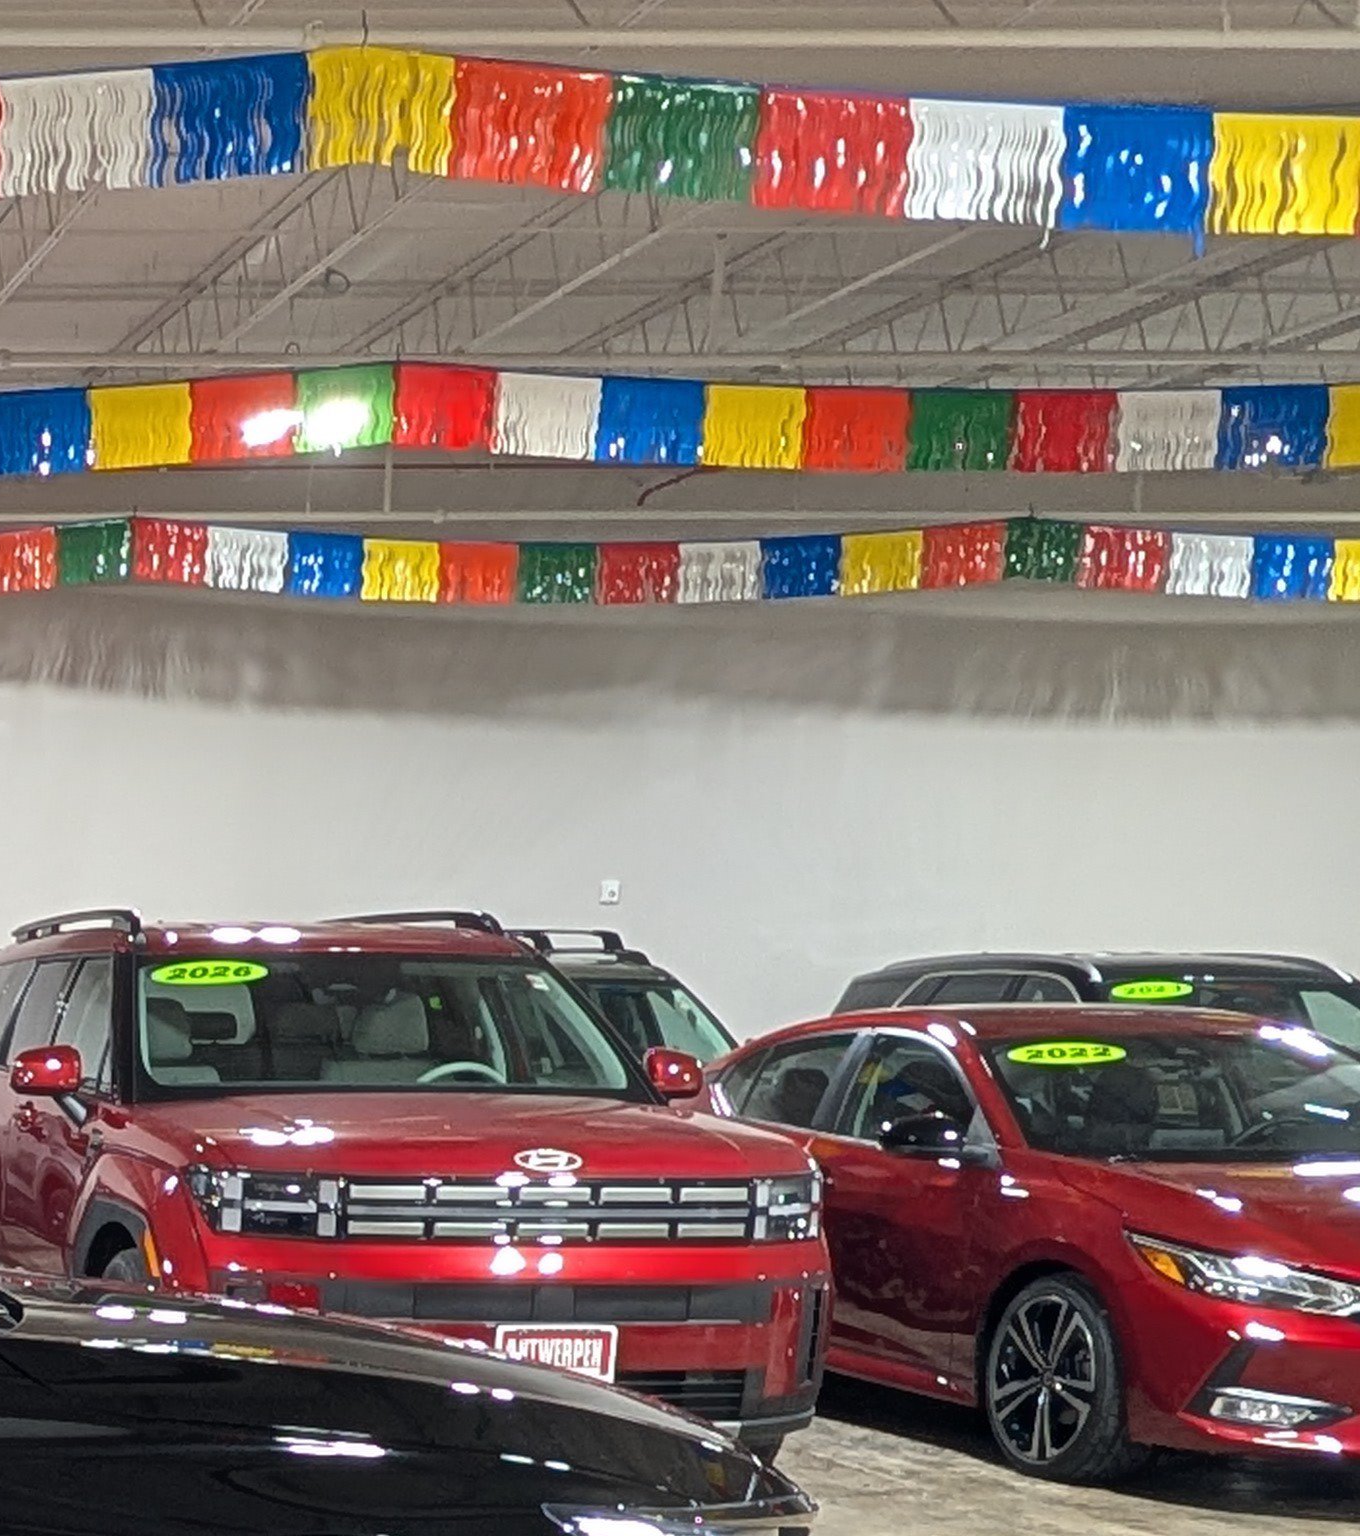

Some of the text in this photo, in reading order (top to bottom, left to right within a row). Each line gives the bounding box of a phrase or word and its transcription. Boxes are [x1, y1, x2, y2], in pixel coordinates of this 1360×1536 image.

[165, 965, 254, 980] 2026
[1025, 1046, 1112, 1060] 2022
[505, 1338, 603, 1368] ANTWERPEN
